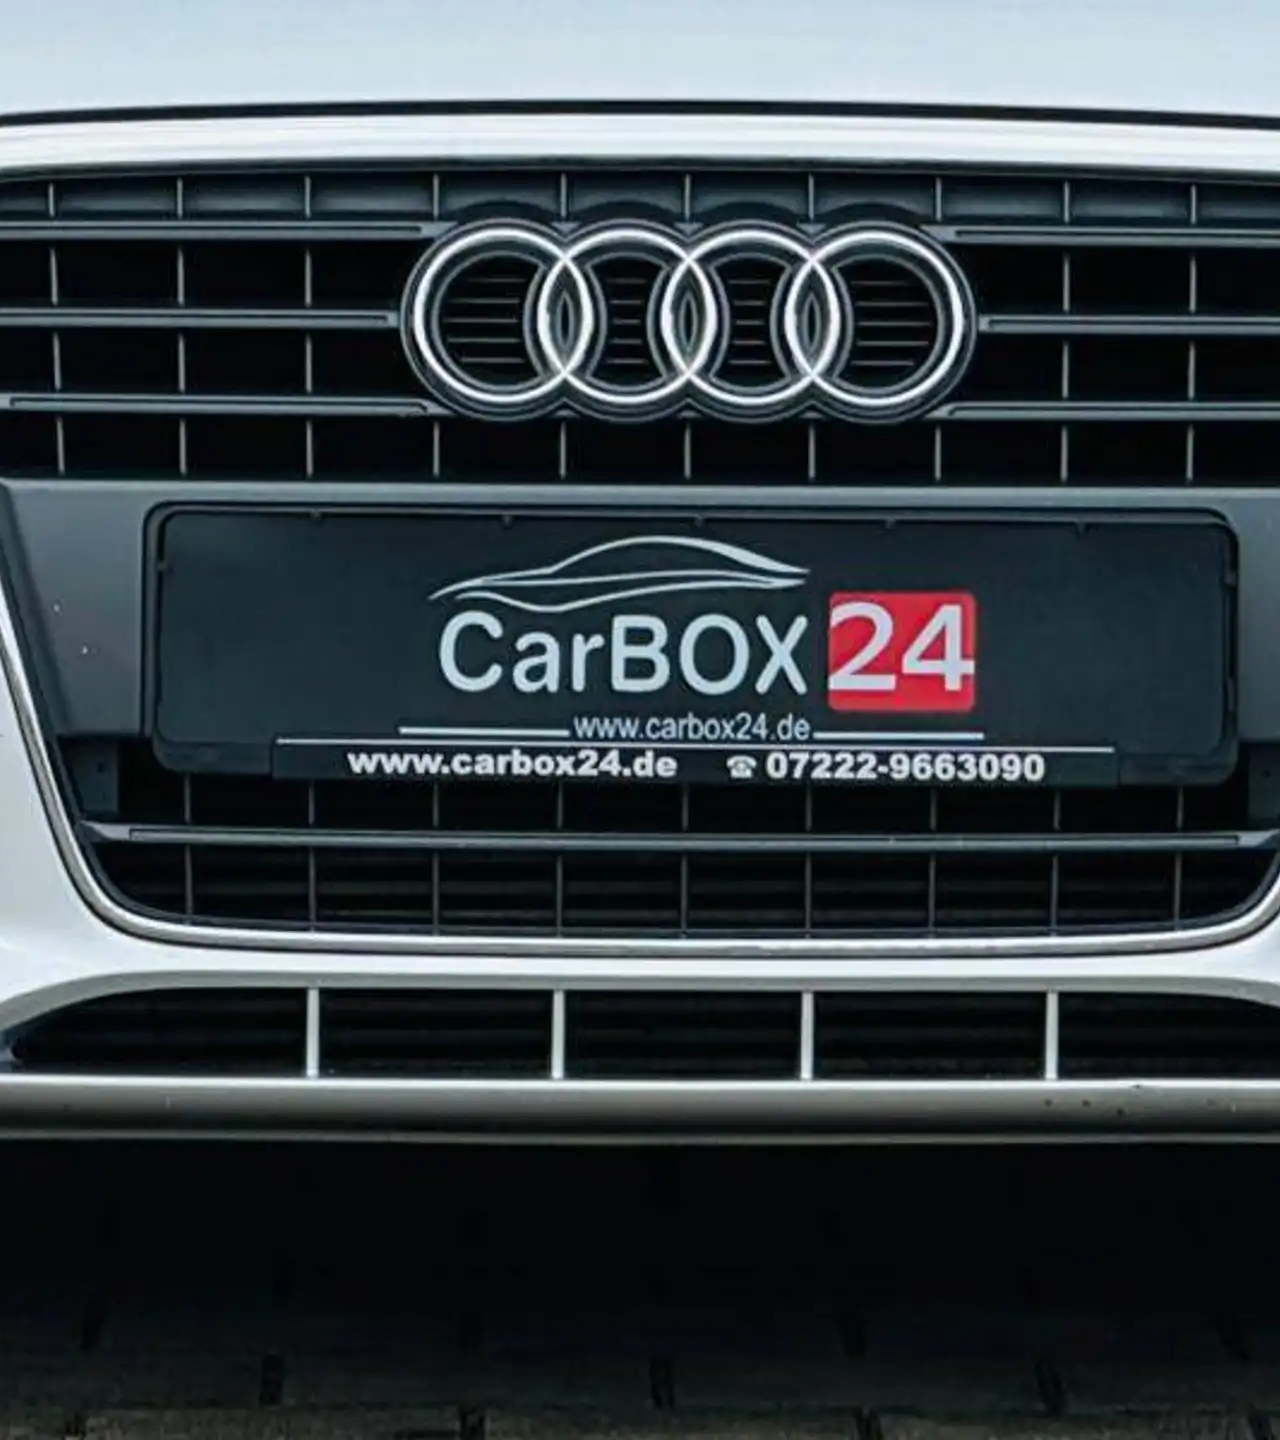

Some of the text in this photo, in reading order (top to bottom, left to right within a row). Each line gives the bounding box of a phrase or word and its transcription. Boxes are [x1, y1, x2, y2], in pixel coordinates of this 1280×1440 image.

[827, 601, 976, 692] 24
[573, 712, 812, 742] www.carbox24.de
[347, 749, 1046, 781] www.carbox24.de 07222-9663090
